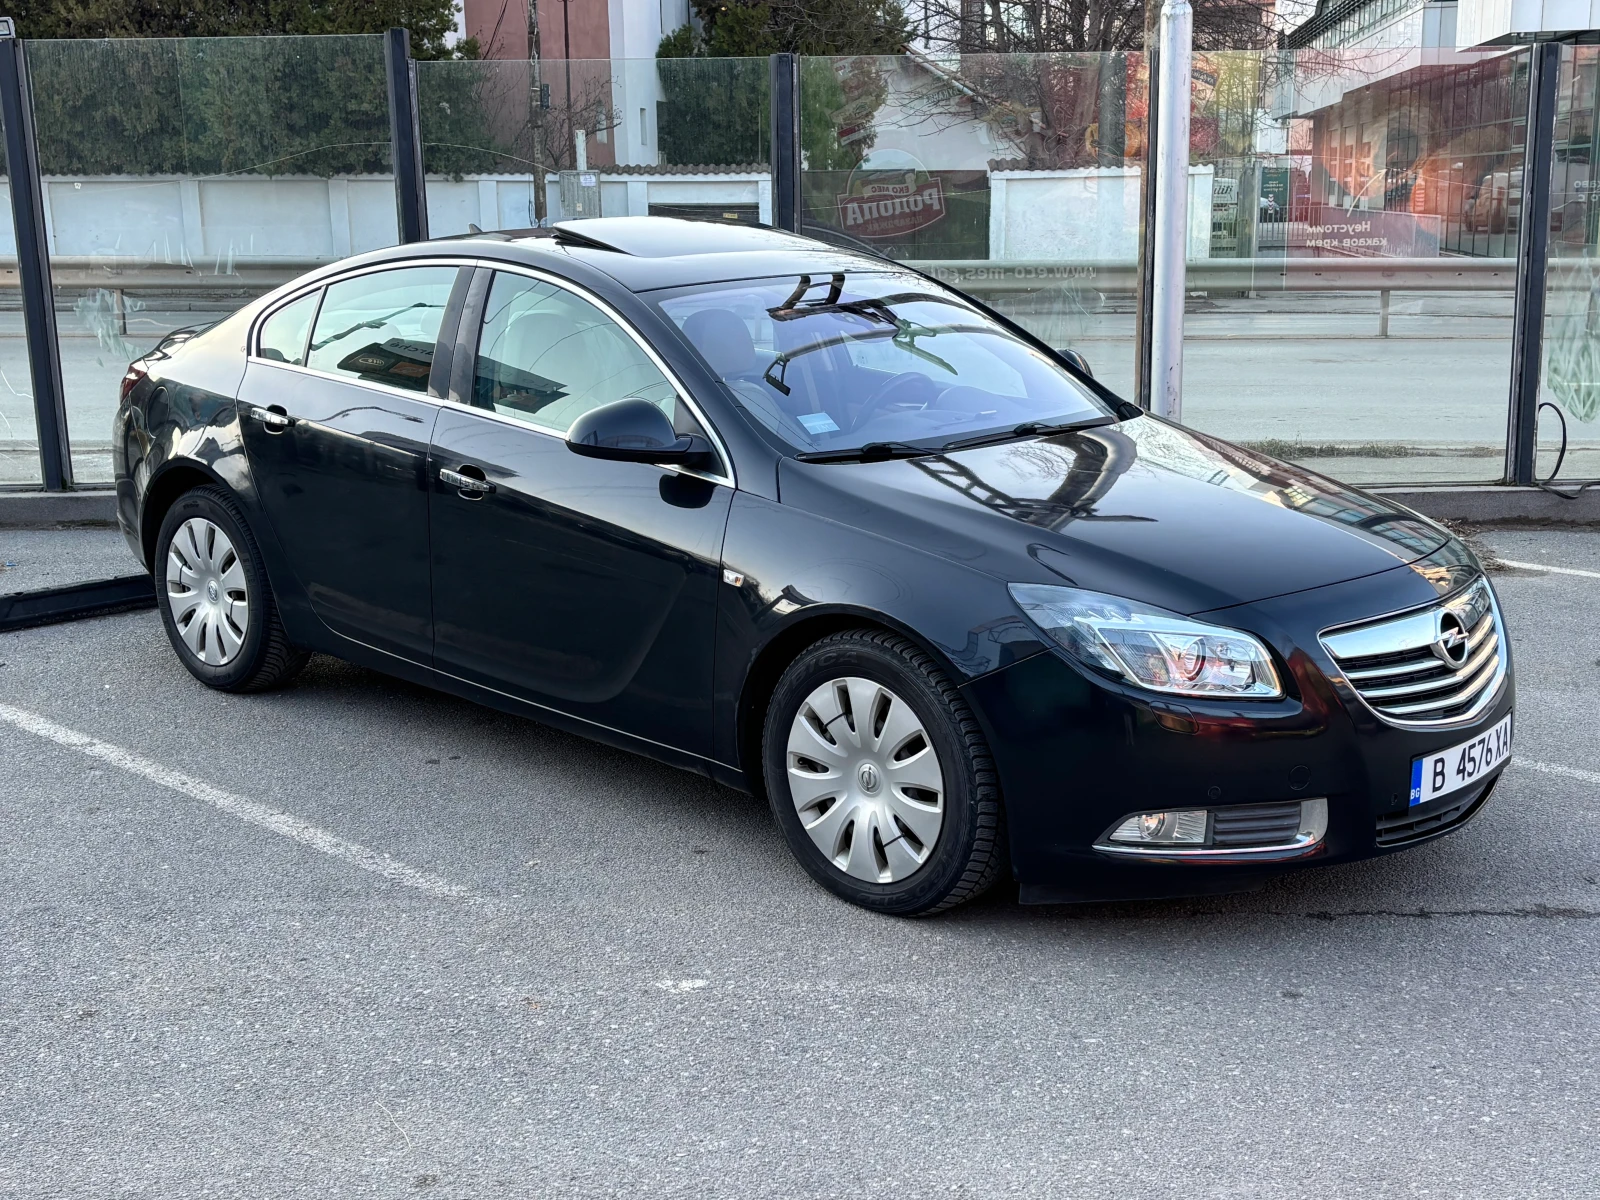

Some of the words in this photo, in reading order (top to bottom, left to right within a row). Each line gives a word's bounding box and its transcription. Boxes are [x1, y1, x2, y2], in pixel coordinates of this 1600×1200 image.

[1432, 757, 1446, 793] B
[1456, 733, 1493, 781] 4576
[1495, 721, 1508, 762] XA
[1410, 787, 1420, 800] BG
